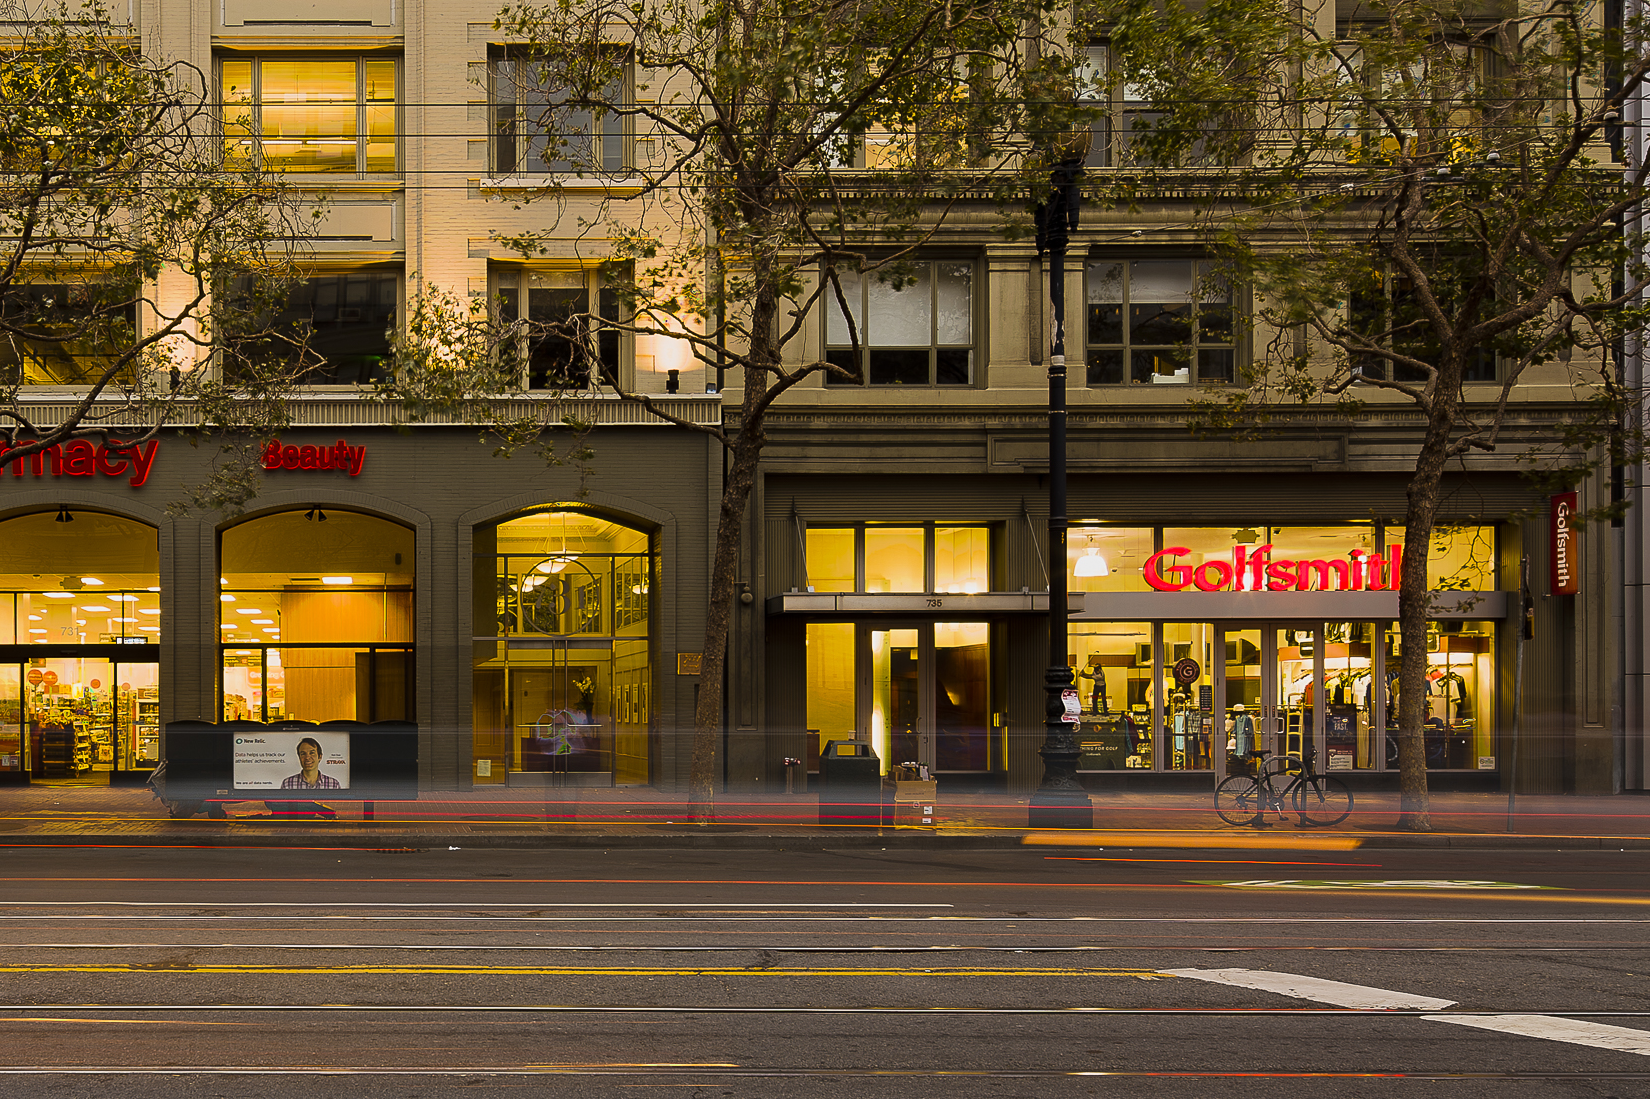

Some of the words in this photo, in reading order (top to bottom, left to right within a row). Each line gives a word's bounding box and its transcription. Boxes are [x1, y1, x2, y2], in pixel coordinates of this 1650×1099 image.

[260, 439, 366, 476] Beauty
[1557, 501, 1570, 588] Golfsmith
[535, 579, 586, 616] 731
[926, 599, 943, 607] 735
[60, 627, 79, 636] 731
